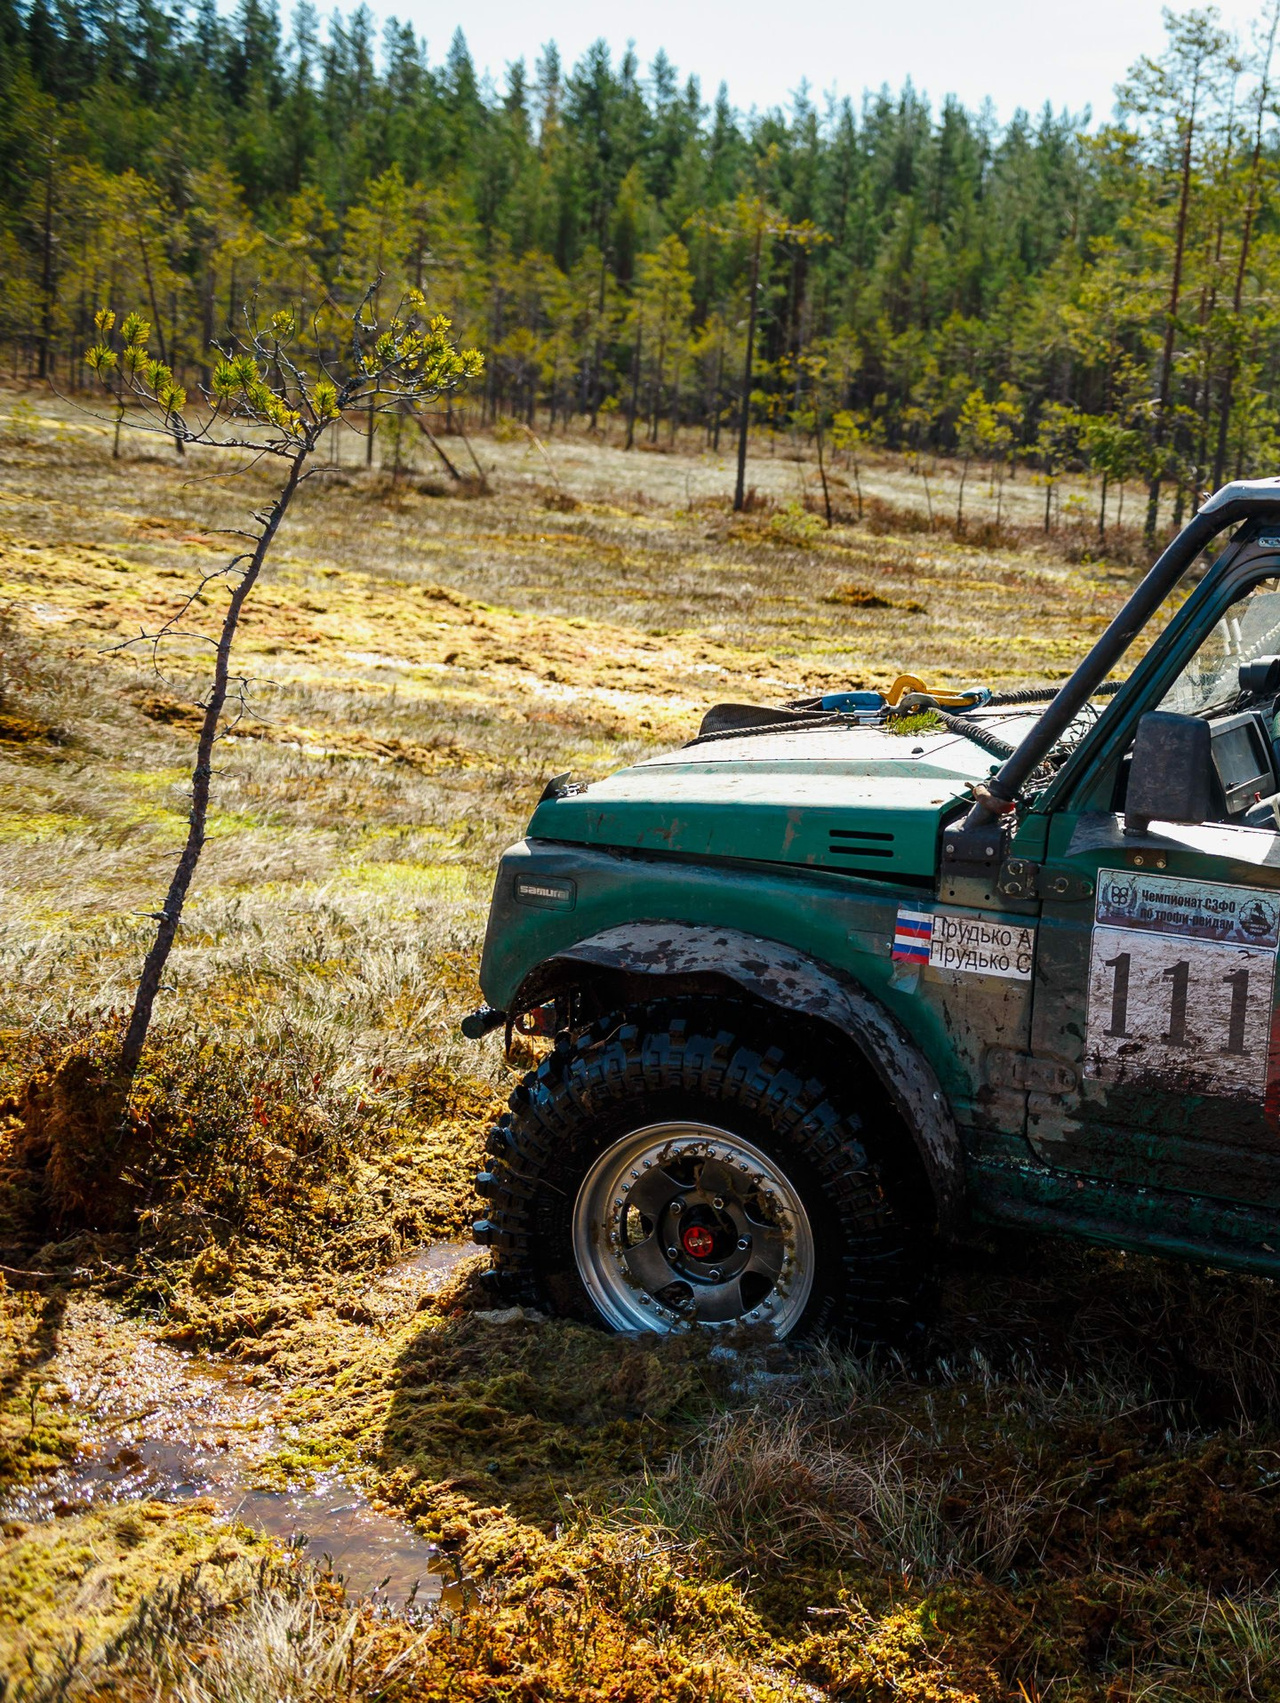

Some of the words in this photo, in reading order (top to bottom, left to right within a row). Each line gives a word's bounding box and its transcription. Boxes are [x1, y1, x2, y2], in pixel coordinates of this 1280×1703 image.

[1141, 889, 1202, 908] Чемпионат
[1204, 897, 1236, 914] СЗФО
[932, 915, 1012, 947] Прудько
[1016, 928, 1032, 950] А
[1140, 908, 1152, 919] по
[1155, 910, 1235, 931] трофи-рейдам
[930, 940, 1010, 972] Прудько
[1016, 953, 1031, 974] С
[1103, 953, 1251, 1056] 111
